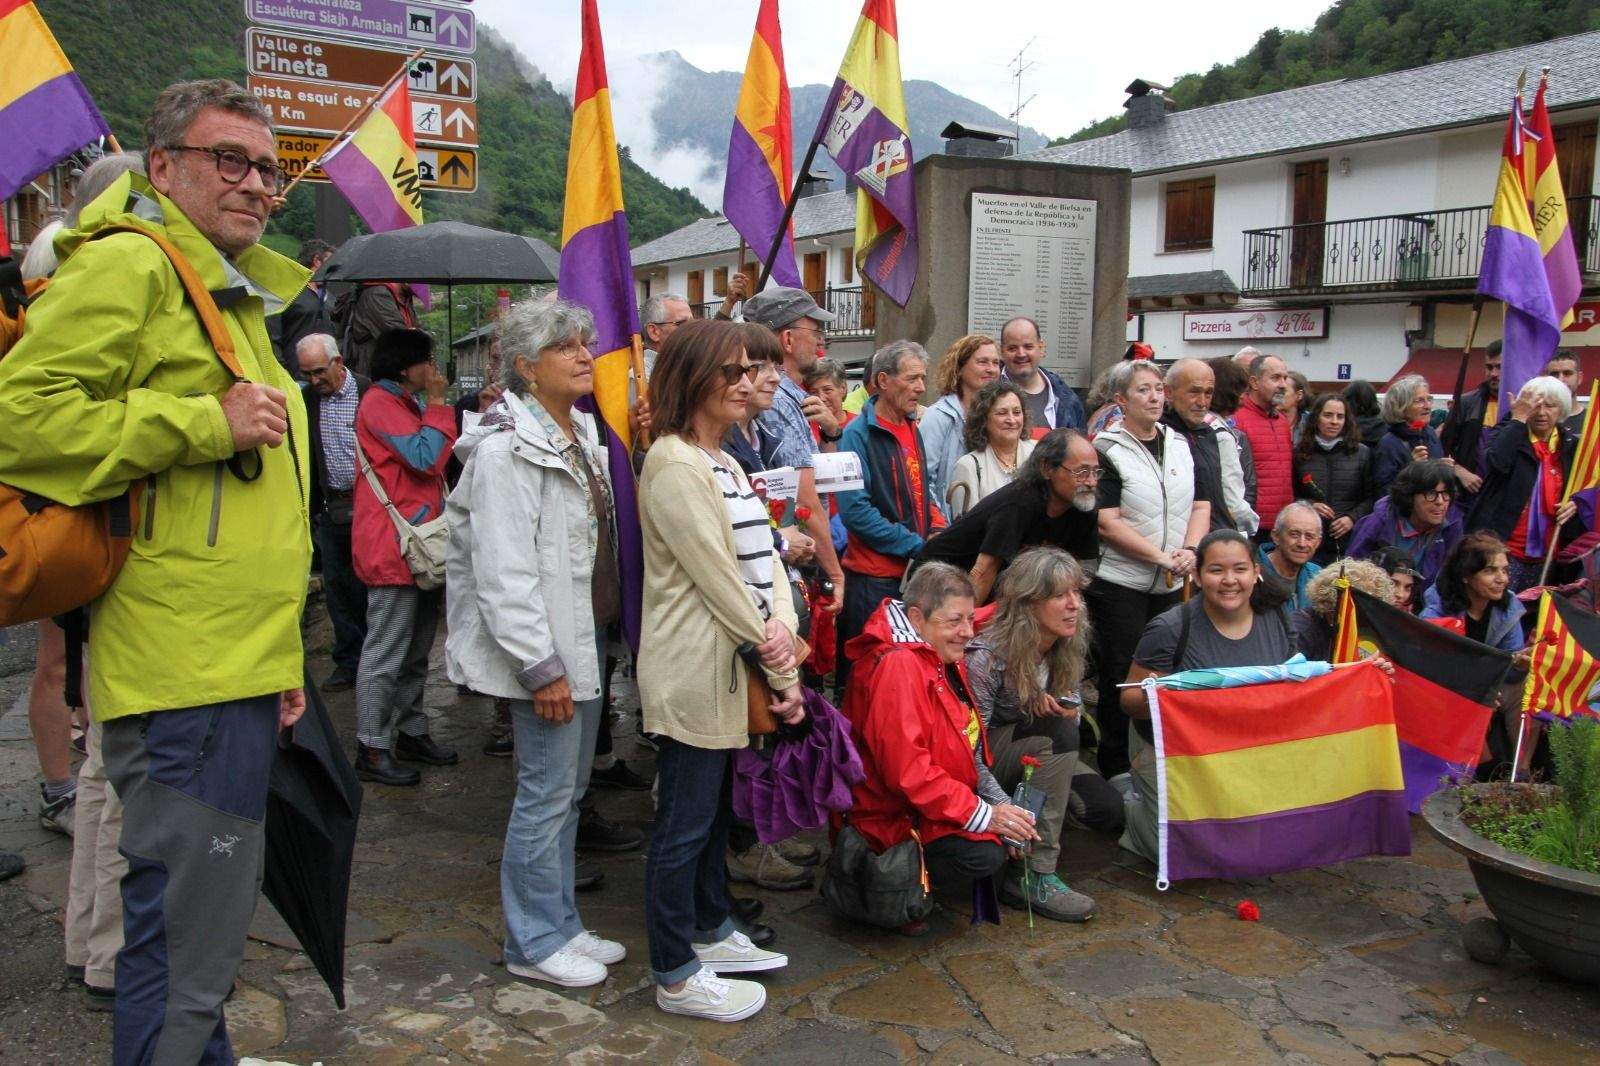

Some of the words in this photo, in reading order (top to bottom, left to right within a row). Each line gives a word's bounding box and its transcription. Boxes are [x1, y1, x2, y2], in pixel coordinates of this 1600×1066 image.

[298, 0, 362, 11] aturaleza
[255, 1, 316, 21] Escultura
[352, 15, 403, 35] Armajani
[256, 34, 298, 53] Valle
[303, 42, 323, 56] de
[256, 51, 328, 78] Pineta
[253, 84, 292, 101] pista
[343, 96, 361, 108] de
[280, 105, 306, 120] Km
[278, 140, 319, 153] rador
[977, 199, 1008, 208] Muertos
[1049, 203, 1058, 211] de
[1060, 204, 1080, 212] Bielsa
[984, 207, 1013, 216] defensa
[1015, 208, 1023, 217] de
[1025, 209, 1033, 217] la
[1034, 210, 1070, 221] República
[1078, 212, 1085, 221] la
[990, 216, 1034, 227] Democracia
[1036, 219, 1079, 231] (1936-1939)
[1190, 319, 1232, 333] Pizzería
[1274, 313, 1290, 334] La
[1578, 309, 1595, 324] R
